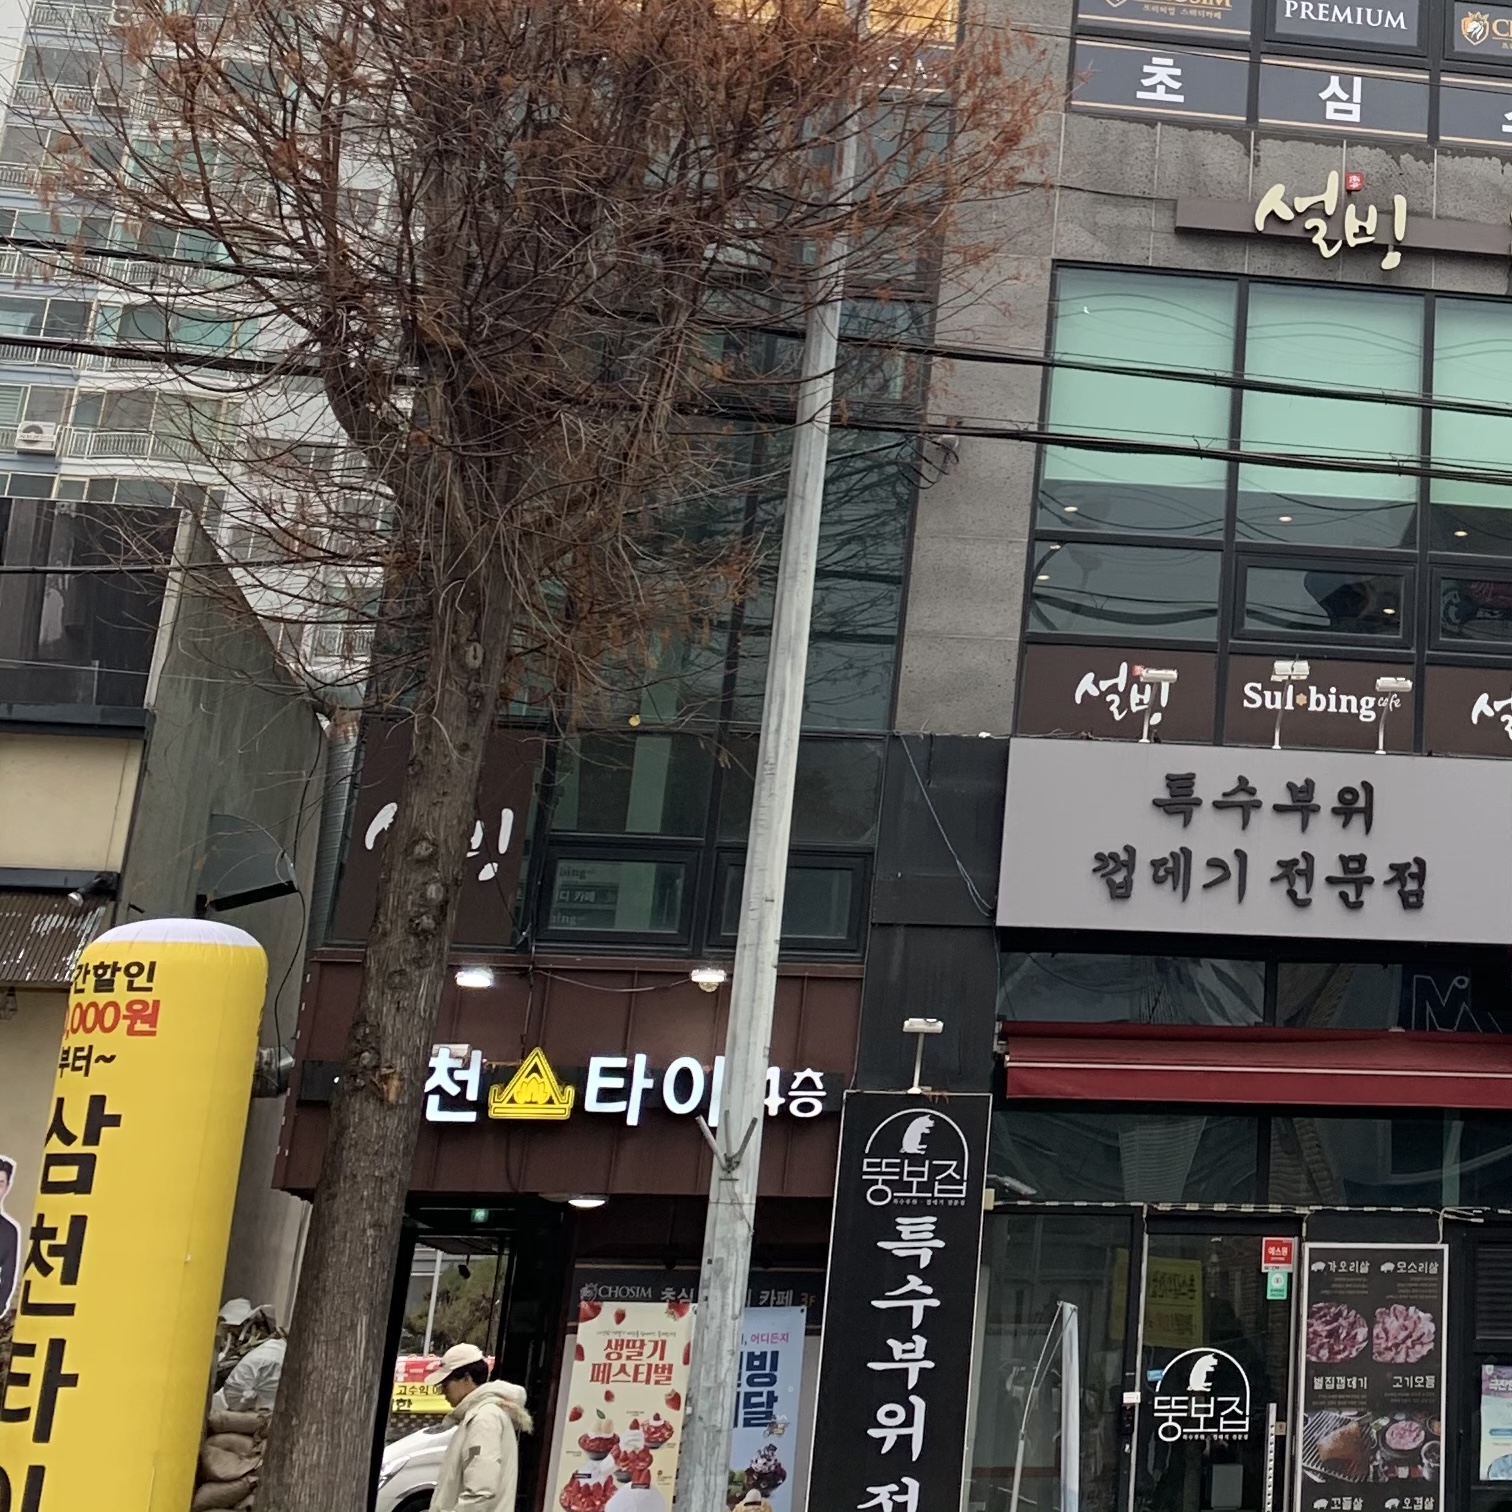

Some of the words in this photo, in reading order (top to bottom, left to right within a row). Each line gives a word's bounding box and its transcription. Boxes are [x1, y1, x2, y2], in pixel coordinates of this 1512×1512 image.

[1284, 0, 1408, 31] PREMIUM
[1255, 170, 1408, 270] 설빙
[1152, 771, 1376, 834] 특수부위
[1092, 844, 1249, 904] 껍데기
[1269, 849, 1429, 912] 전문점
[584, 1053, 726, 1128] 타이
[861, 1157, 967, 1206] 뚱보집
[1327, 1260, 1371, 1274] 가오리살
[1396, 1260, 1440, 1275] 모소리살
[598, 1285, 653, 1299] CHOSIM
[759, 1289, 793, 1307] 카페
[604, 1338, 668, 1361] 생딸기
[750, 1332, 790, 1345] 어디든지
[589, 1362, 674, 1386] 페스티벌
[1153, 1396, 1250, 1443] 뚱보집
